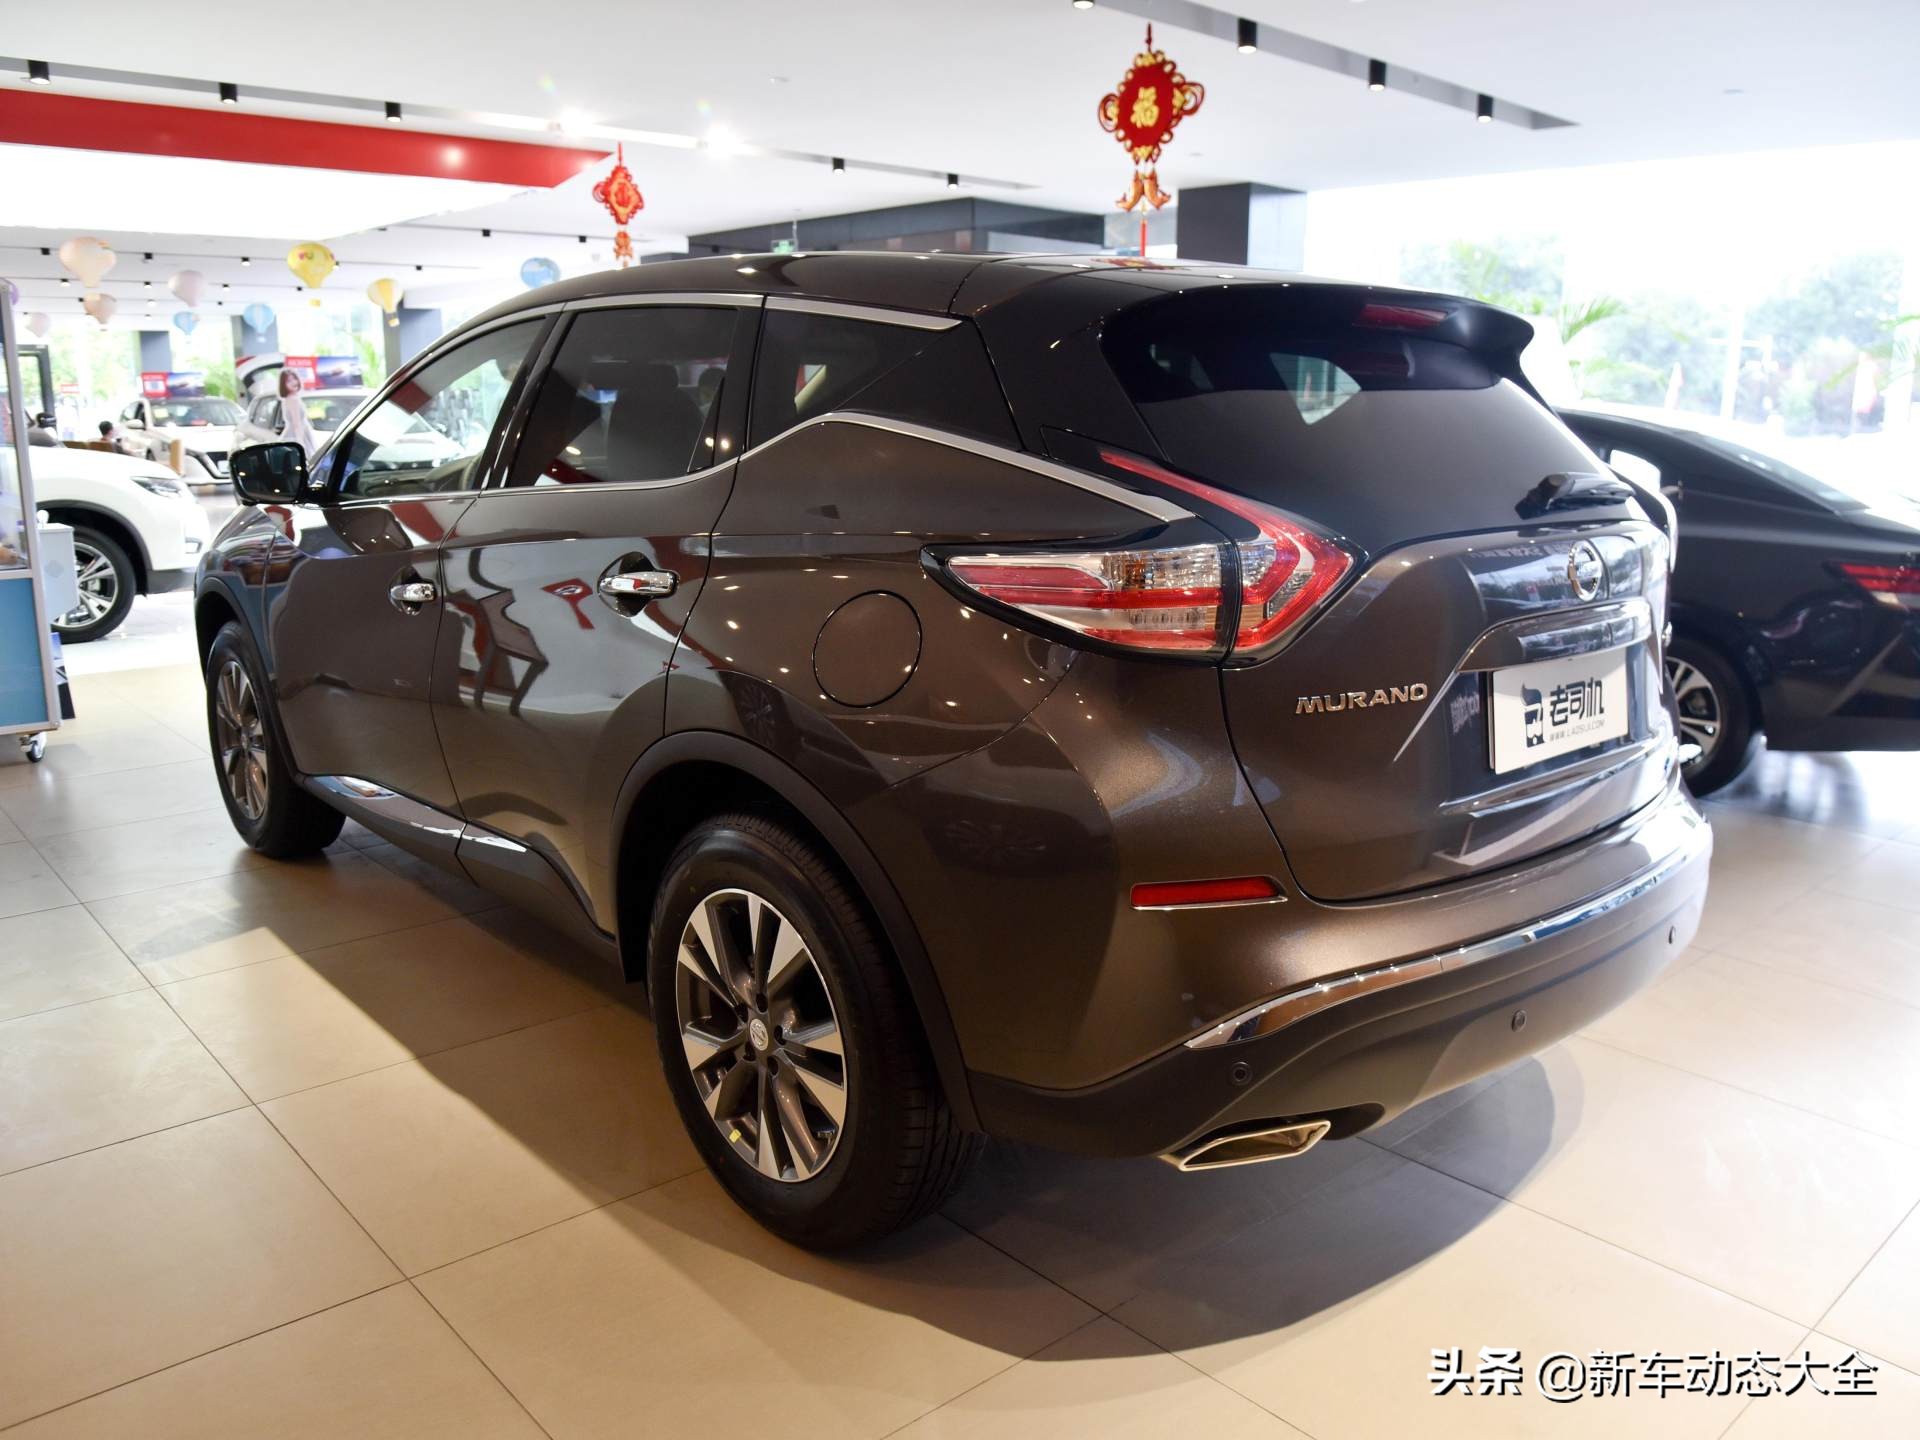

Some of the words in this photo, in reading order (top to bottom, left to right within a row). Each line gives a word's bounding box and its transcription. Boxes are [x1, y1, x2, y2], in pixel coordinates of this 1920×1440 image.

[1130, 86, 1160, 128] 福
[1296, 683, 1428, 714] MURANO
[1549, 677, 1605, 727] 老司机
